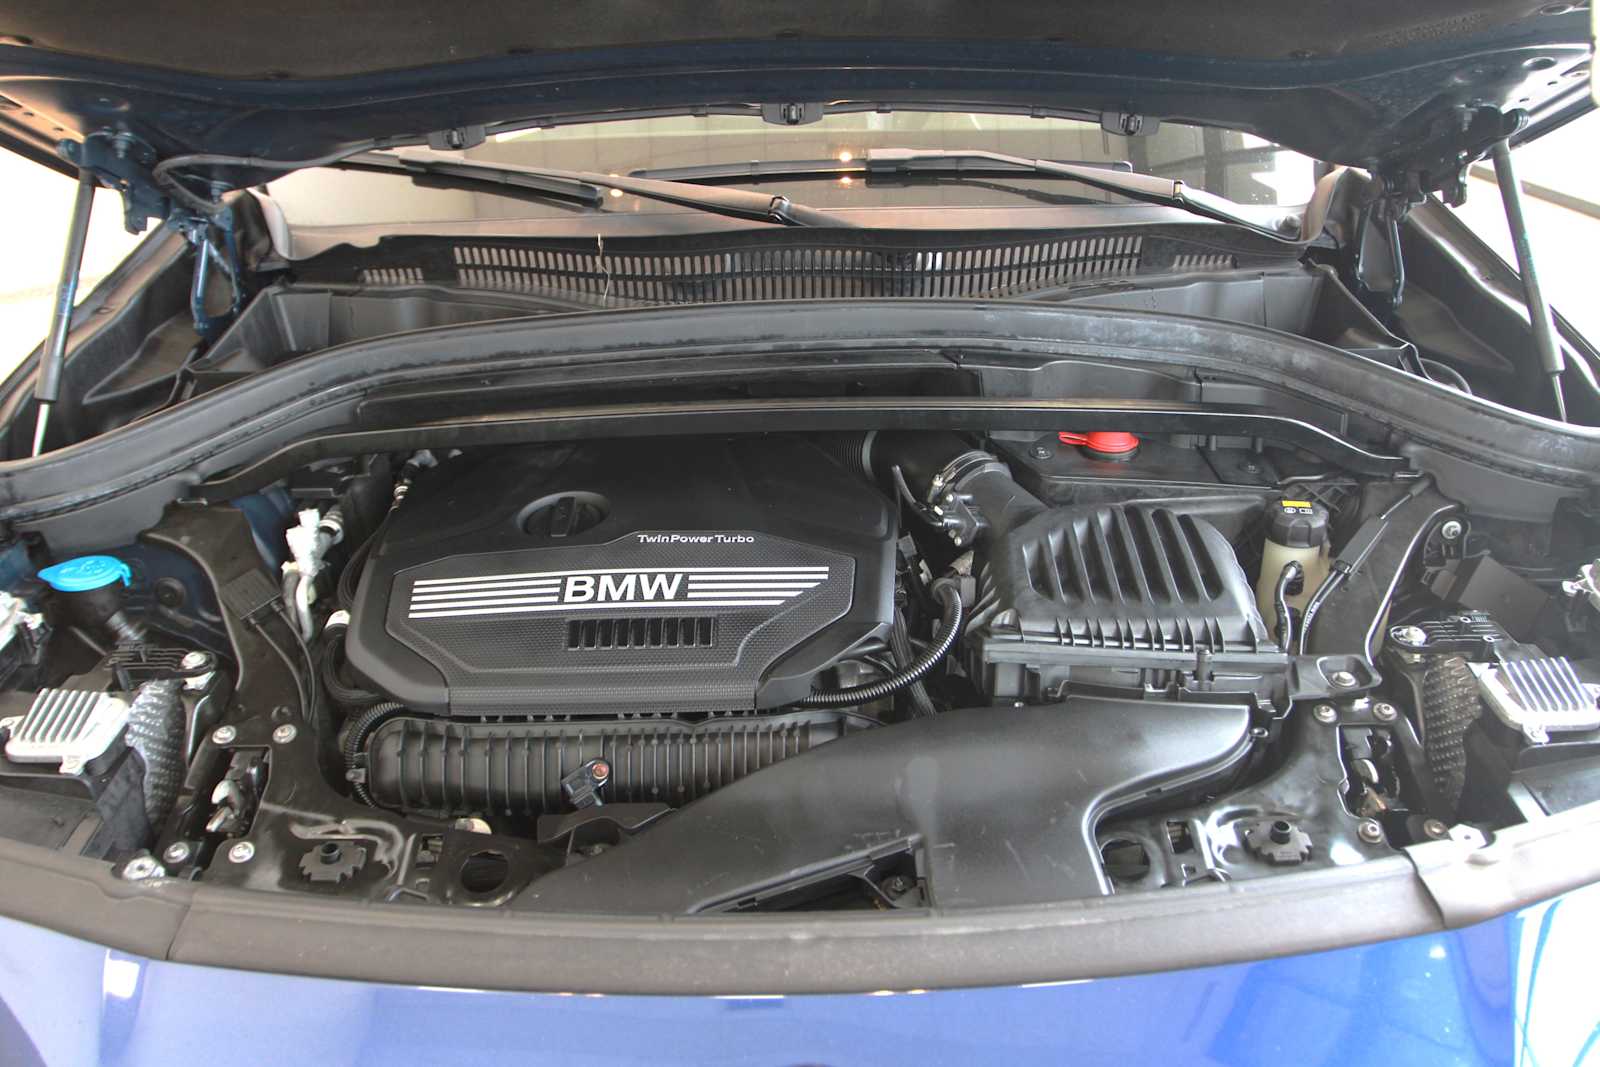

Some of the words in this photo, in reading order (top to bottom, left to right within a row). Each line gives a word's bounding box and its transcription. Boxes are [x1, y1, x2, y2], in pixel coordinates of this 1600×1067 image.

[637, 534, 713, 544] TwinPower
[714, 534, 755, 544] Turbo
[563, 573, 683, 603] BMW
